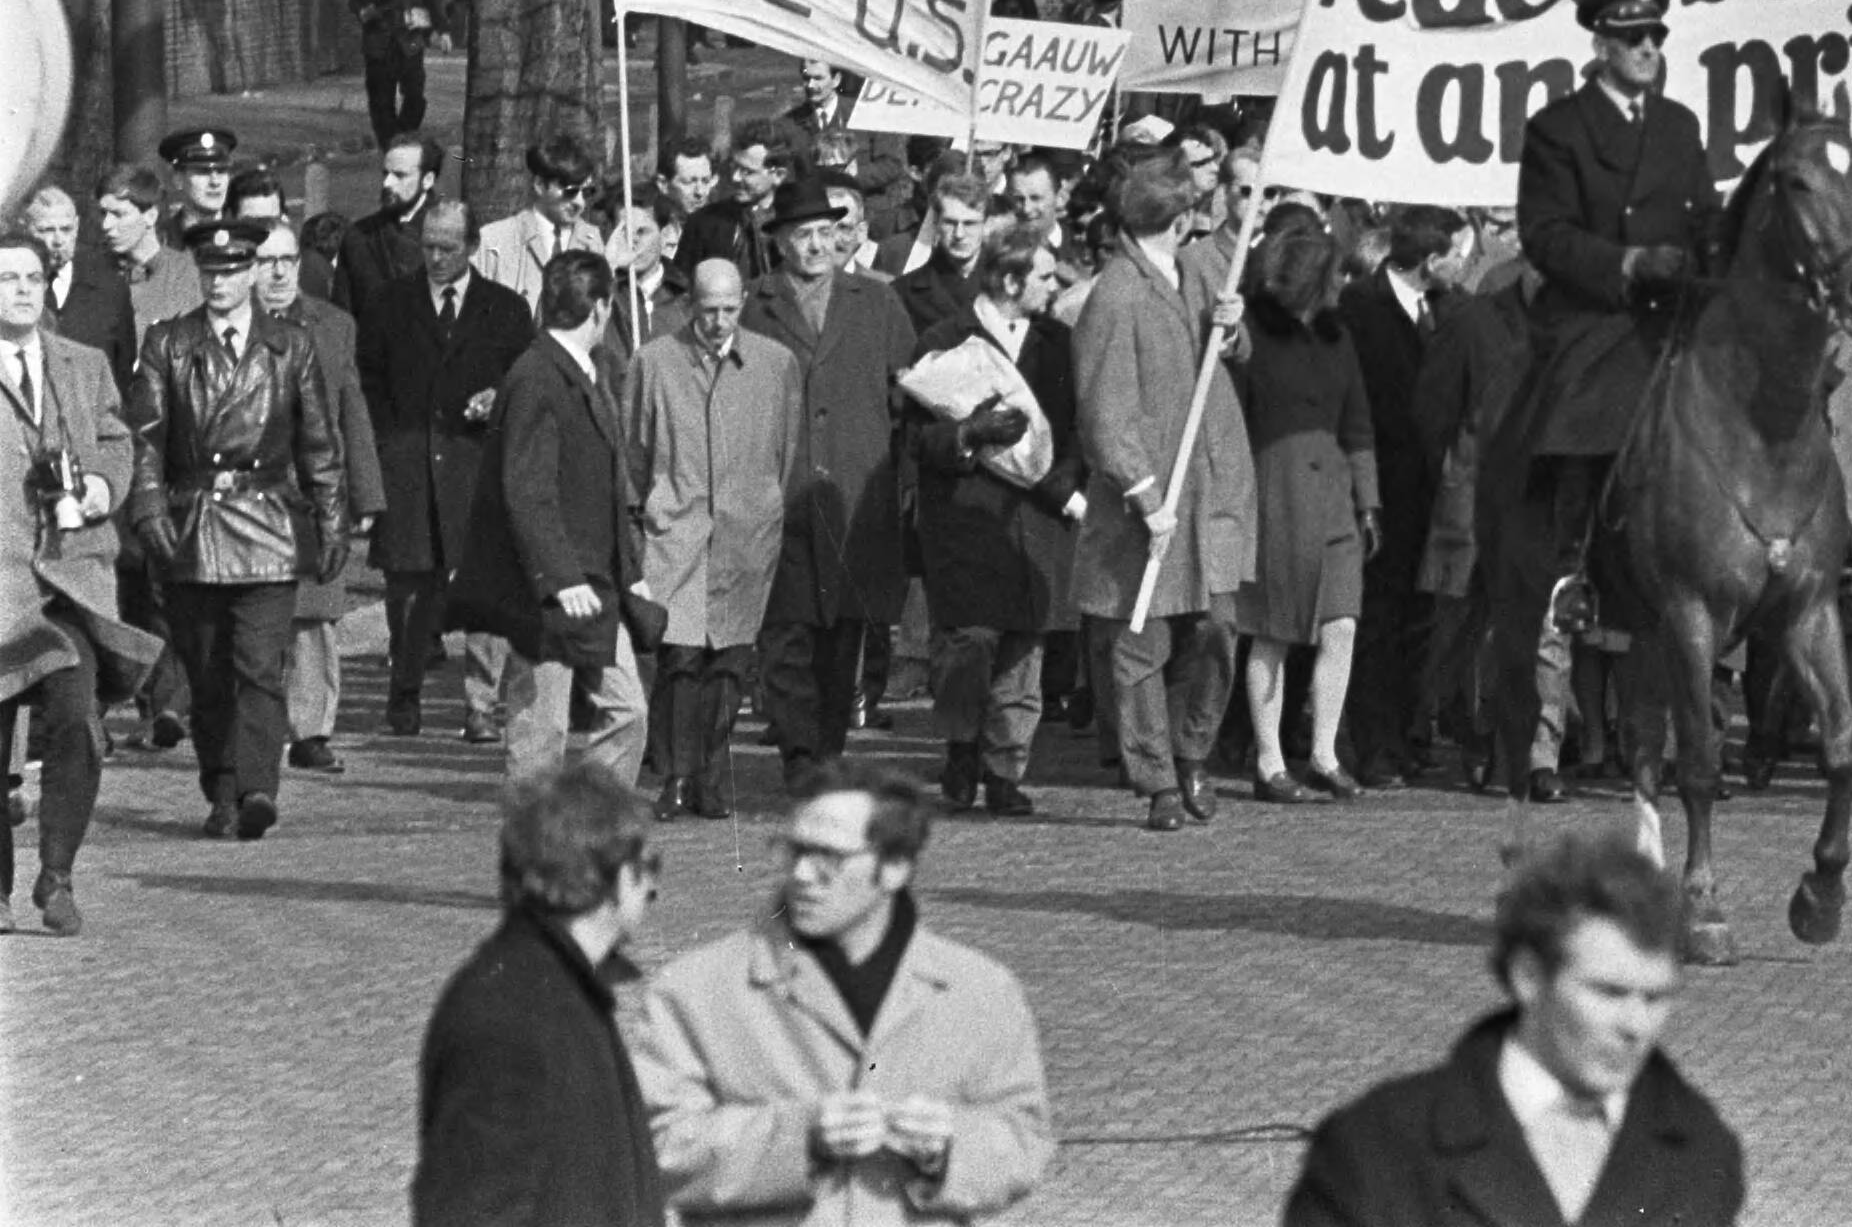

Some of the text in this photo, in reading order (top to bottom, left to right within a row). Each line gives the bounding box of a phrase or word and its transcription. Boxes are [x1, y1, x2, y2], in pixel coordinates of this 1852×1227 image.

[1157, 24, 1281, 67] WITH
[1301, 43, 1396, 160] at
[1416, 58, 1667, 164] an
